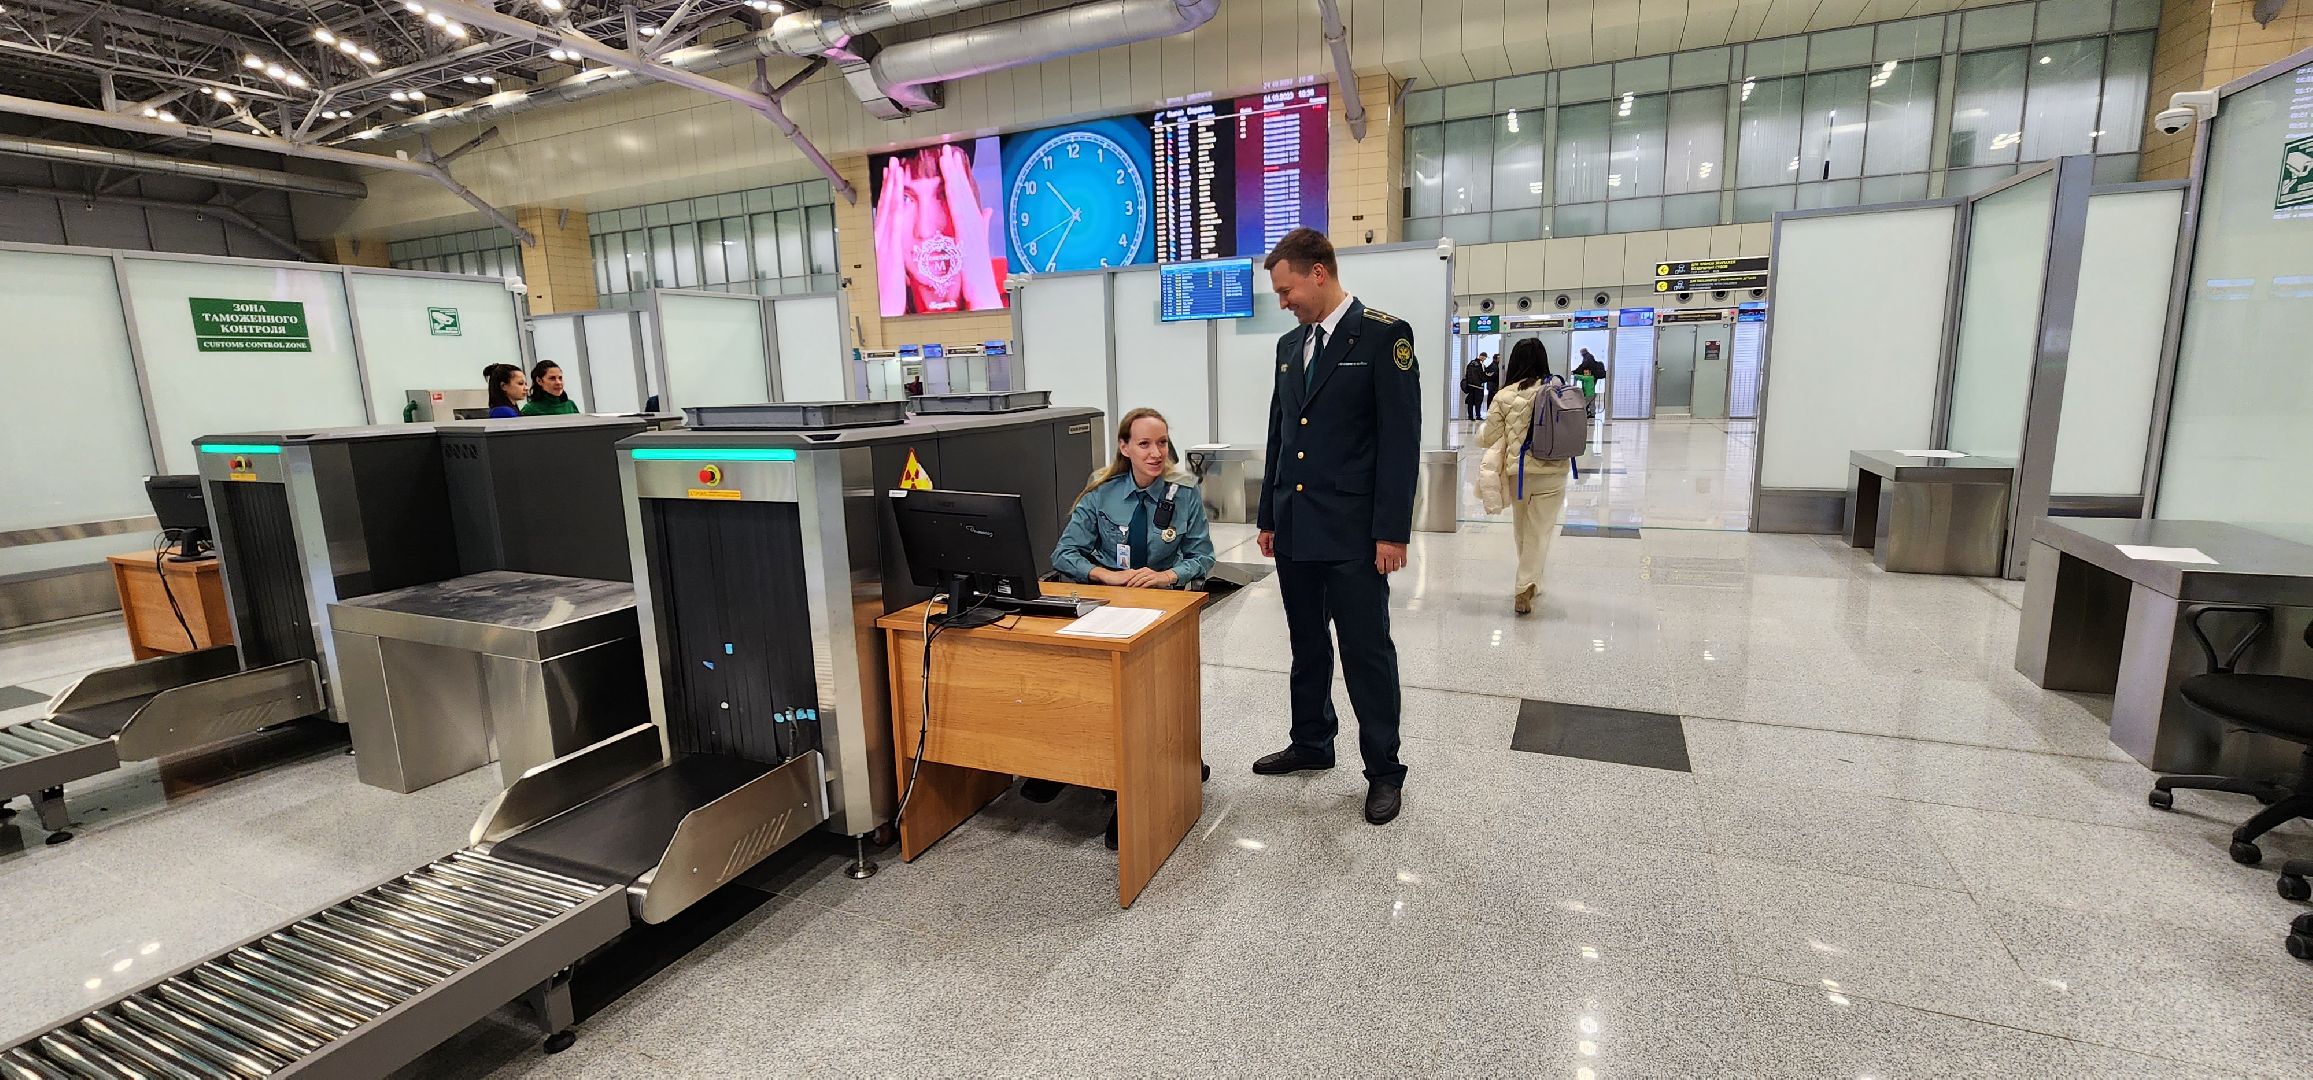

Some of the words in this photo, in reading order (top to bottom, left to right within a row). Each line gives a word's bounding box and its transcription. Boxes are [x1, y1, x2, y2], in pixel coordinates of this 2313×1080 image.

[1066, 143, 1080, 158] 12
[1097, 148, 1103, 163] 1
[1042, 155, 1053, 170] 11
[1116, 169, 1125, 184] 2
[1023, 180, 1037, 195] 10
[1124, 200, 1133, 216] 3
[1020, 212, 1029, 227] 9
[1118, 233, 1128, 247] 4
[1029, 241, 1037, 256] 8
[232, 303, 267, 313] ЗОНА
[202, 312, 298, 324] ТАМОЖЕННОГО
[220, 324, 286, 334] КОНТРОЛЯ
[245, 341, 285, 349] CONTROL
